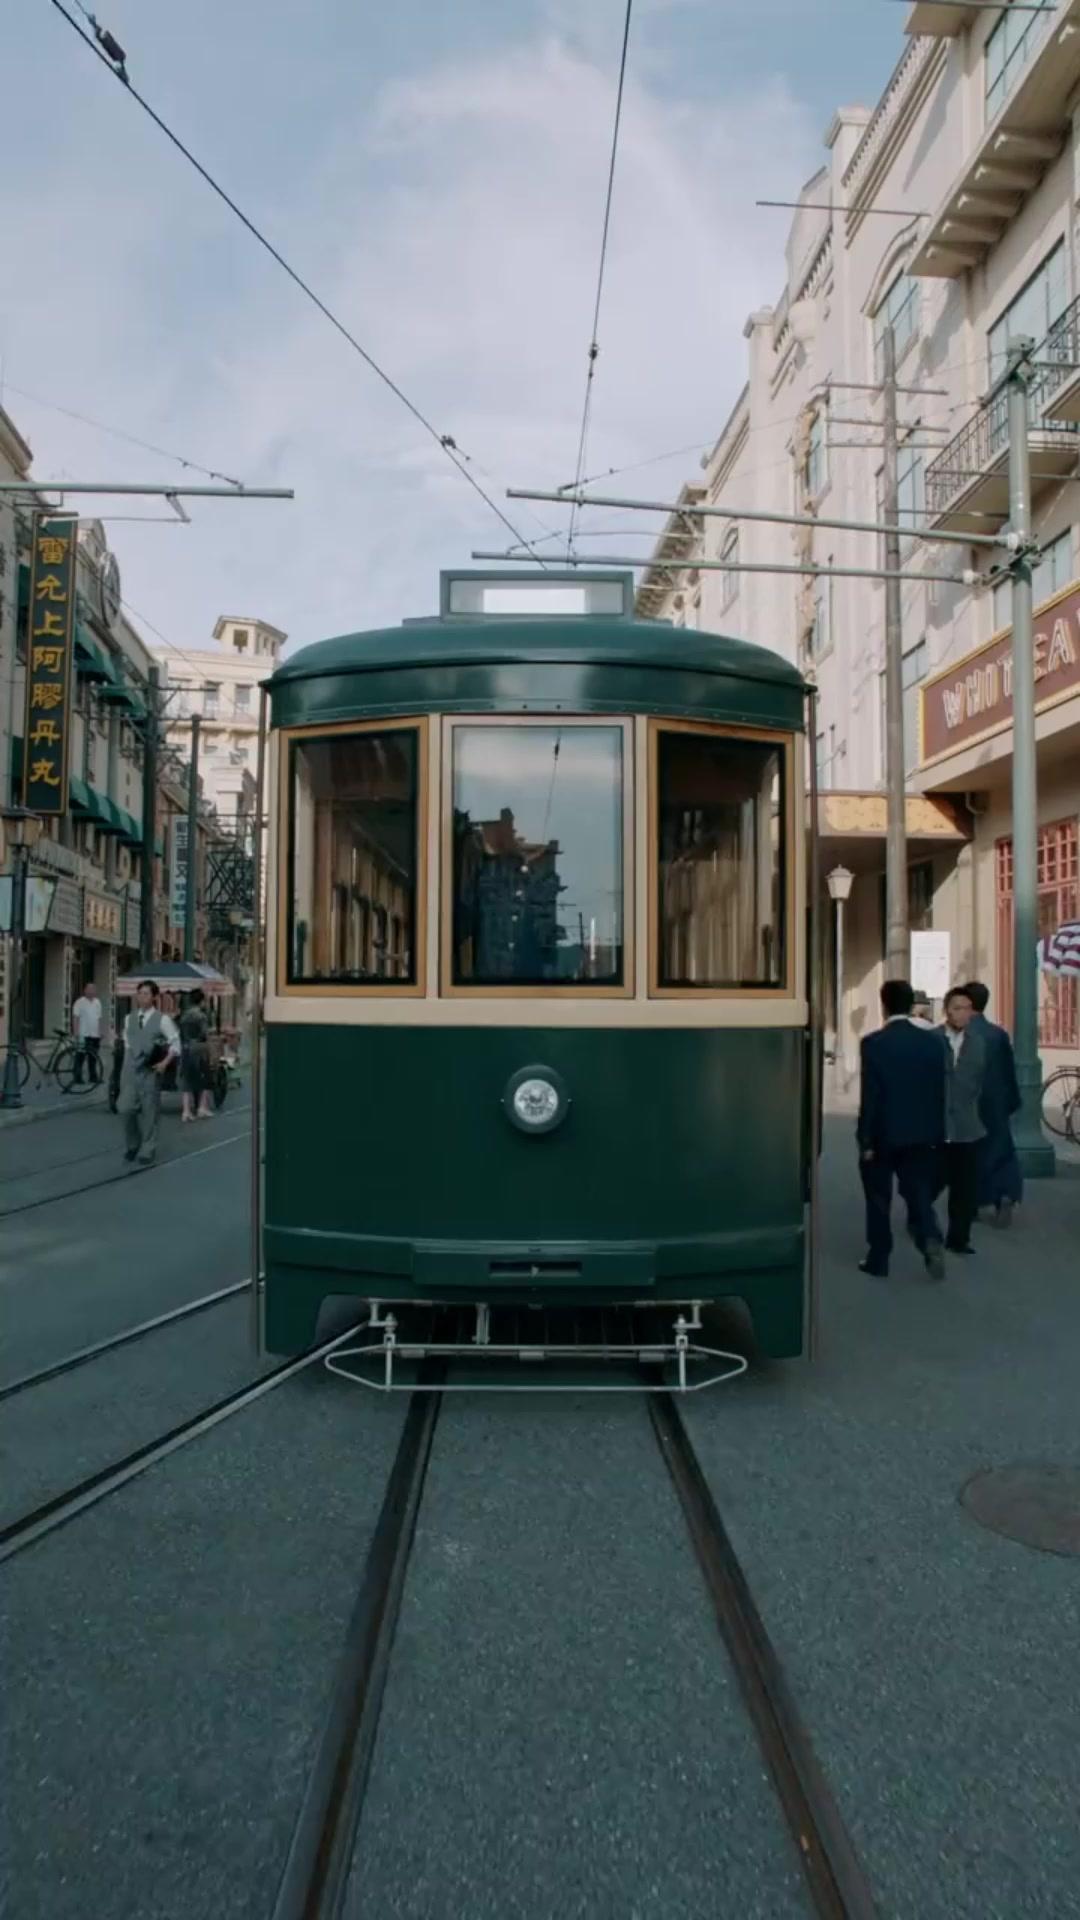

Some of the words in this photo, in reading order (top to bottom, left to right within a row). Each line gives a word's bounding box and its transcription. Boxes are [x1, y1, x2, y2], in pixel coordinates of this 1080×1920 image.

[29, 537, 68, 786] 雷允上阿膠丹丸
